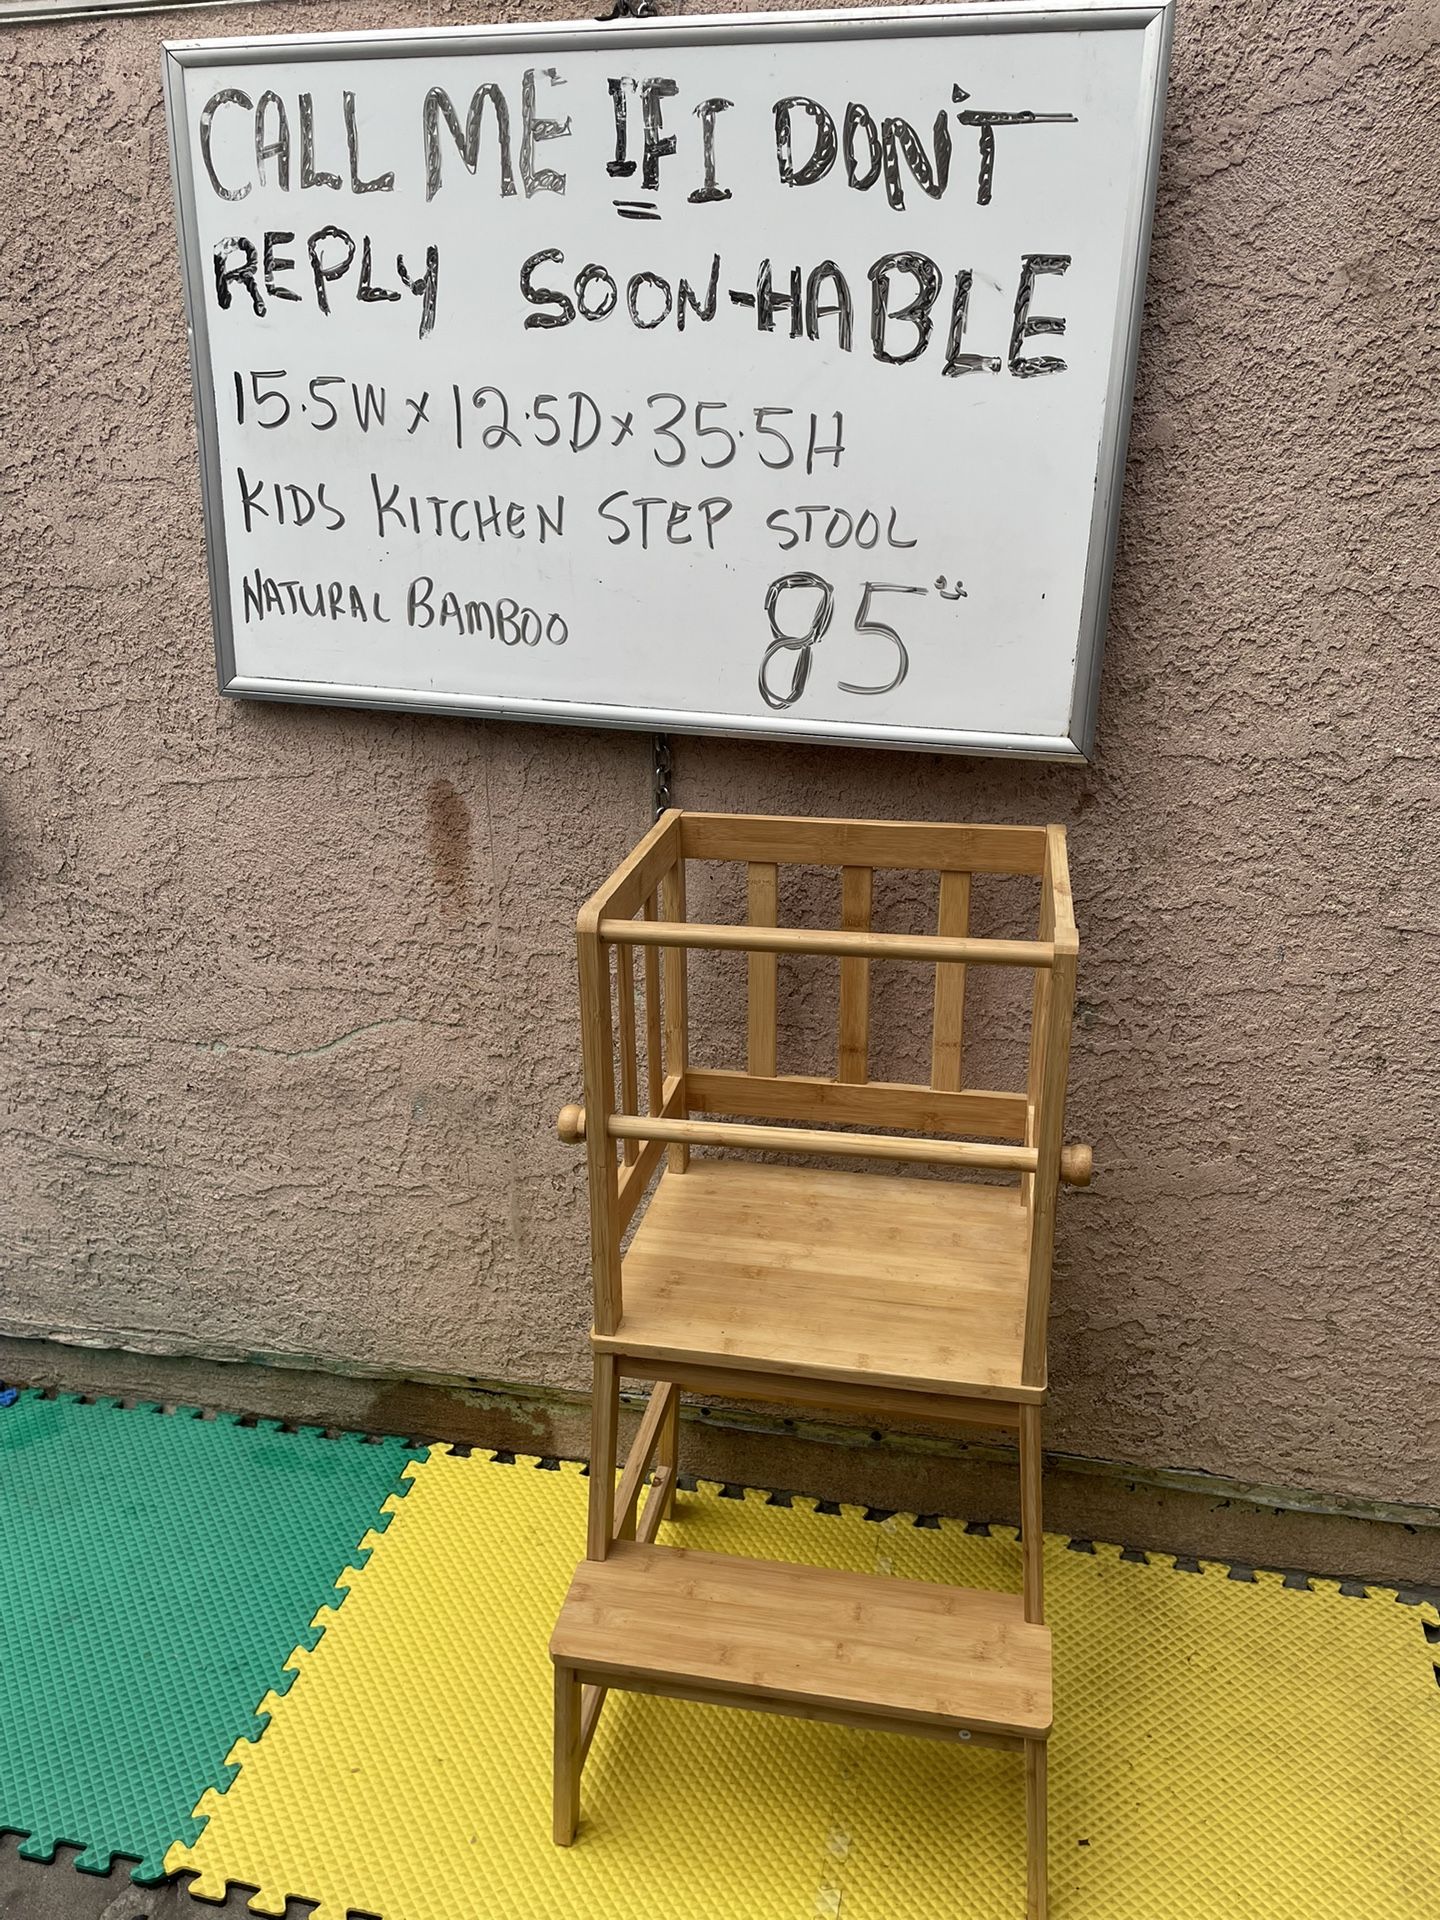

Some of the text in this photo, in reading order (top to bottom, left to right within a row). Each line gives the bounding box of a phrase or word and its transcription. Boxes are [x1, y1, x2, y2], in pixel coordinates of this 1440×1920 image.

[200, 68, 1079, 211] CALL ME IF I DON'T
[213, 225, 438, 341] REPLY
[237, 467, 918, 551] KIDS KITCHEN STEP STOOL
[243, 568, 569, 646] NATURAL BAMBOO
